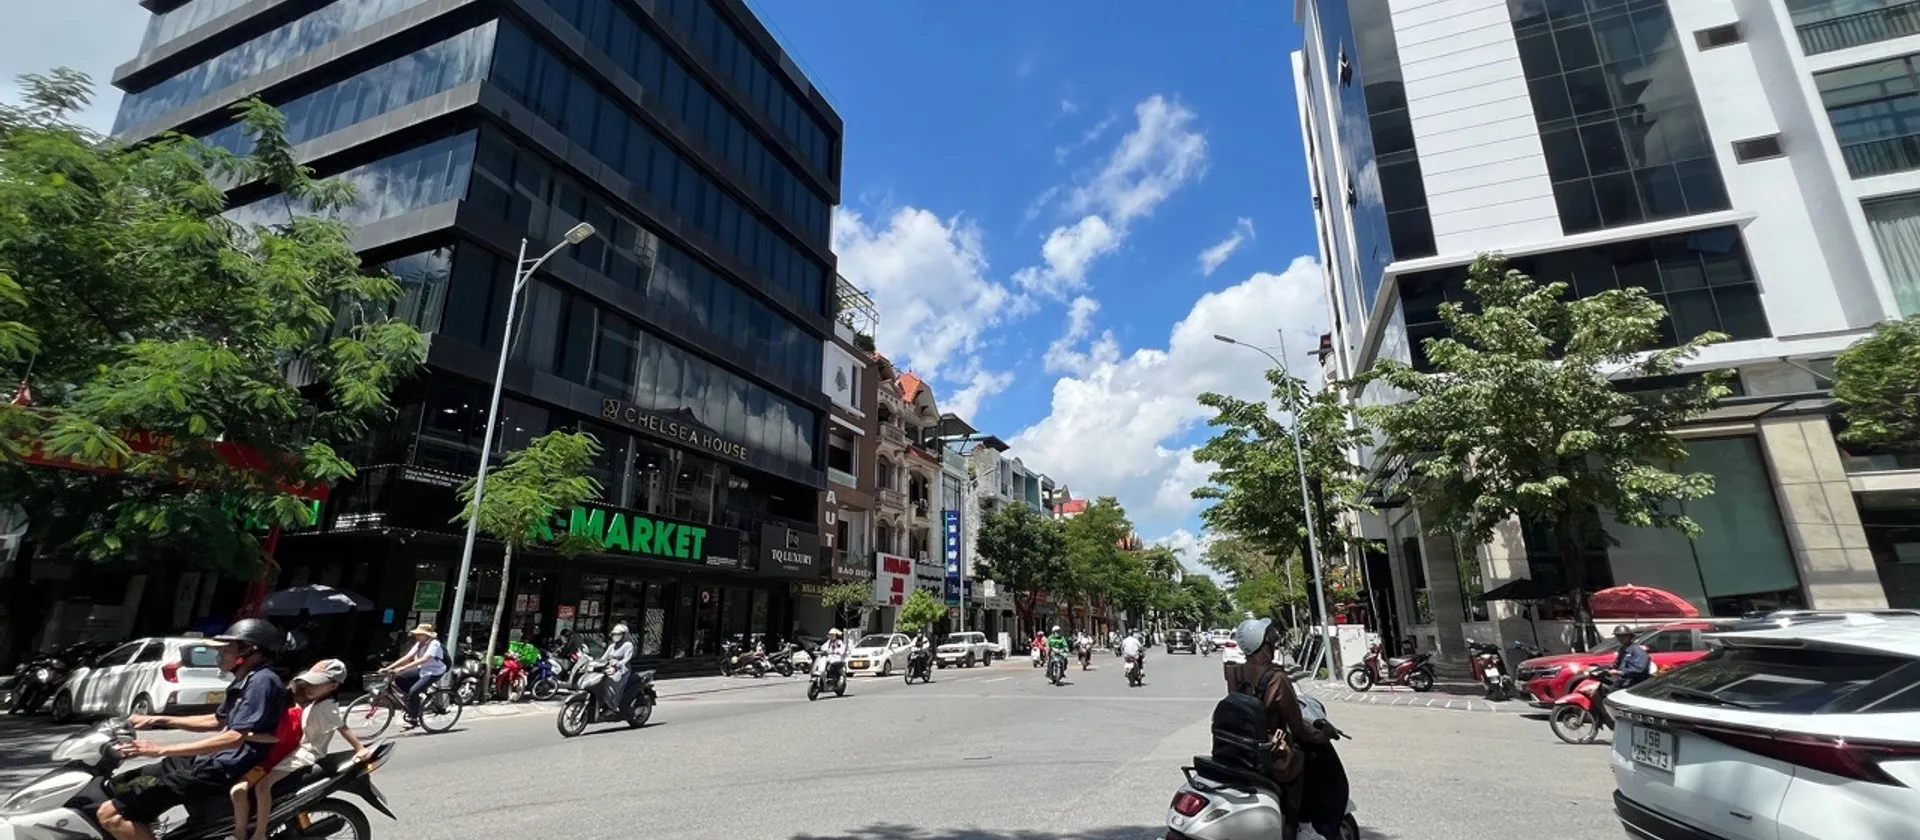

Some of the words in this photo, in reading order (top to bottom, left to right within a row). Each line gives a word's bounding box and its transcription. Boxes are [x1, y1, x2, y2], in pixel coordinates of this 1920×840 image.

[624, 407, 699, 445] CHELSEA
[703, 434, 747, 461] HOUSE
[783, 551, 813, 565] LUXURY
